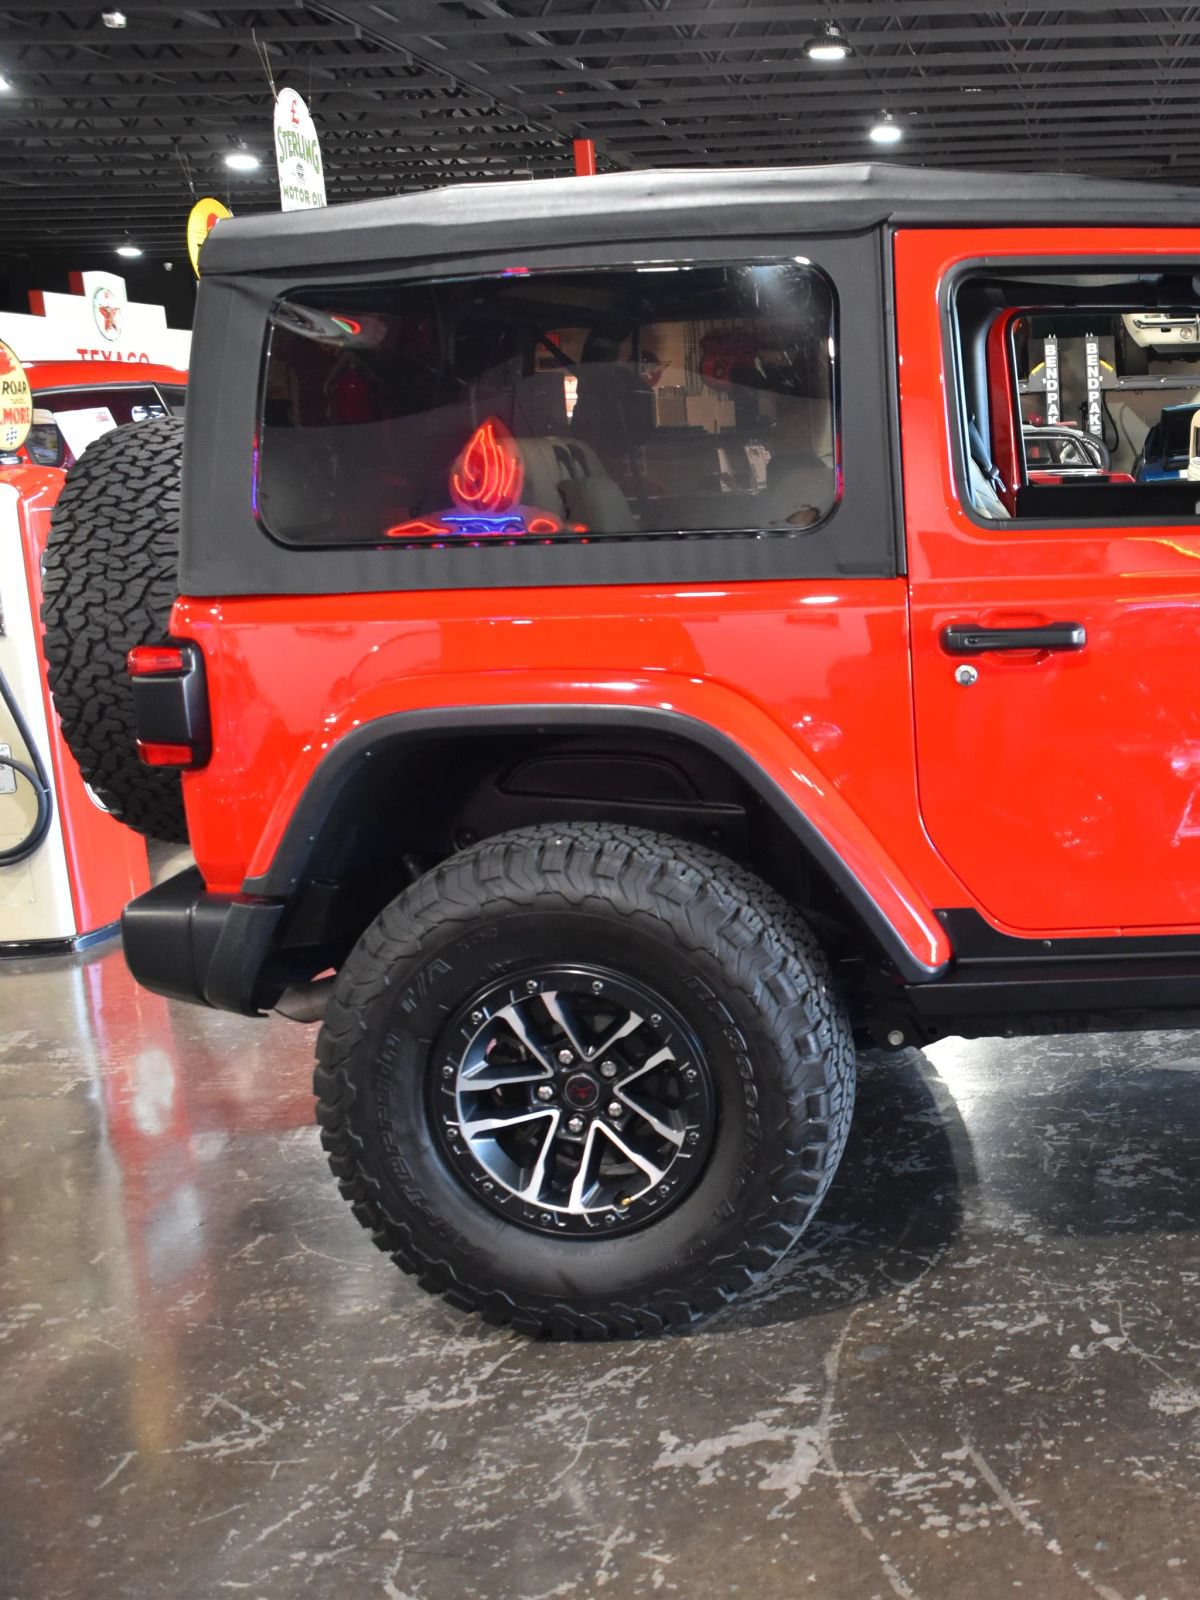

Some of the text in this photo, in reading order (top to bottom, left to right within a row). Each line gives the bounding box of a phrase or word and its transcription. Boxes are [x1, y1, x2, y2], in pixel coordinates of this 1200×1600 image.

[277, 126, 320, 174] STERLING
[283, 184, 311, 205] MOTOR
[2, 381, 27, 395] ROAR
